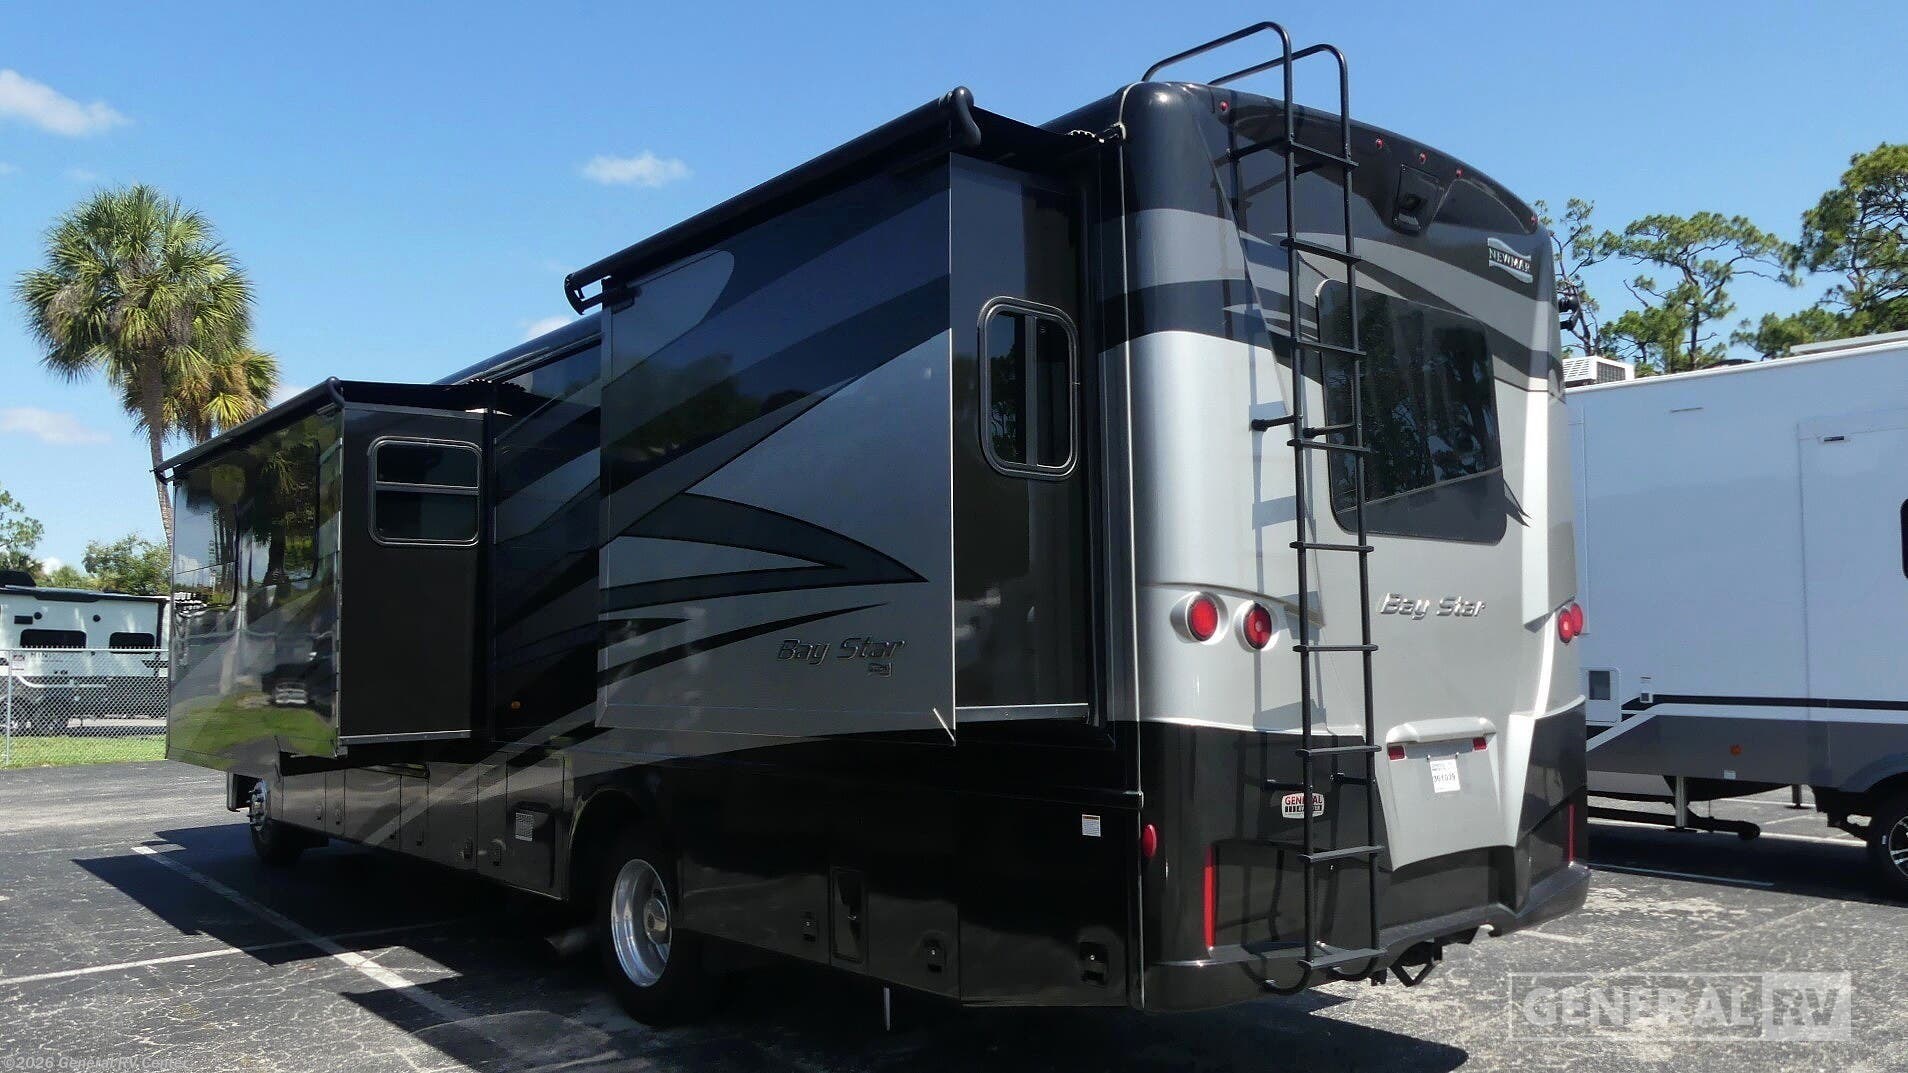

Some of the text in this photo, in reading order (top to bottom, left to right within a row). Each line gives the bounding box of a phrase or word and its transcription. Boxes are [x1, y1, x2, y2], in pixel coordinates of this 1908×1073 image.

[1380, 592, 1487, 621] Bay Star
[777, 637, 905, 666] Bay Star
[1285, 796, 1323, 805] GENAL
